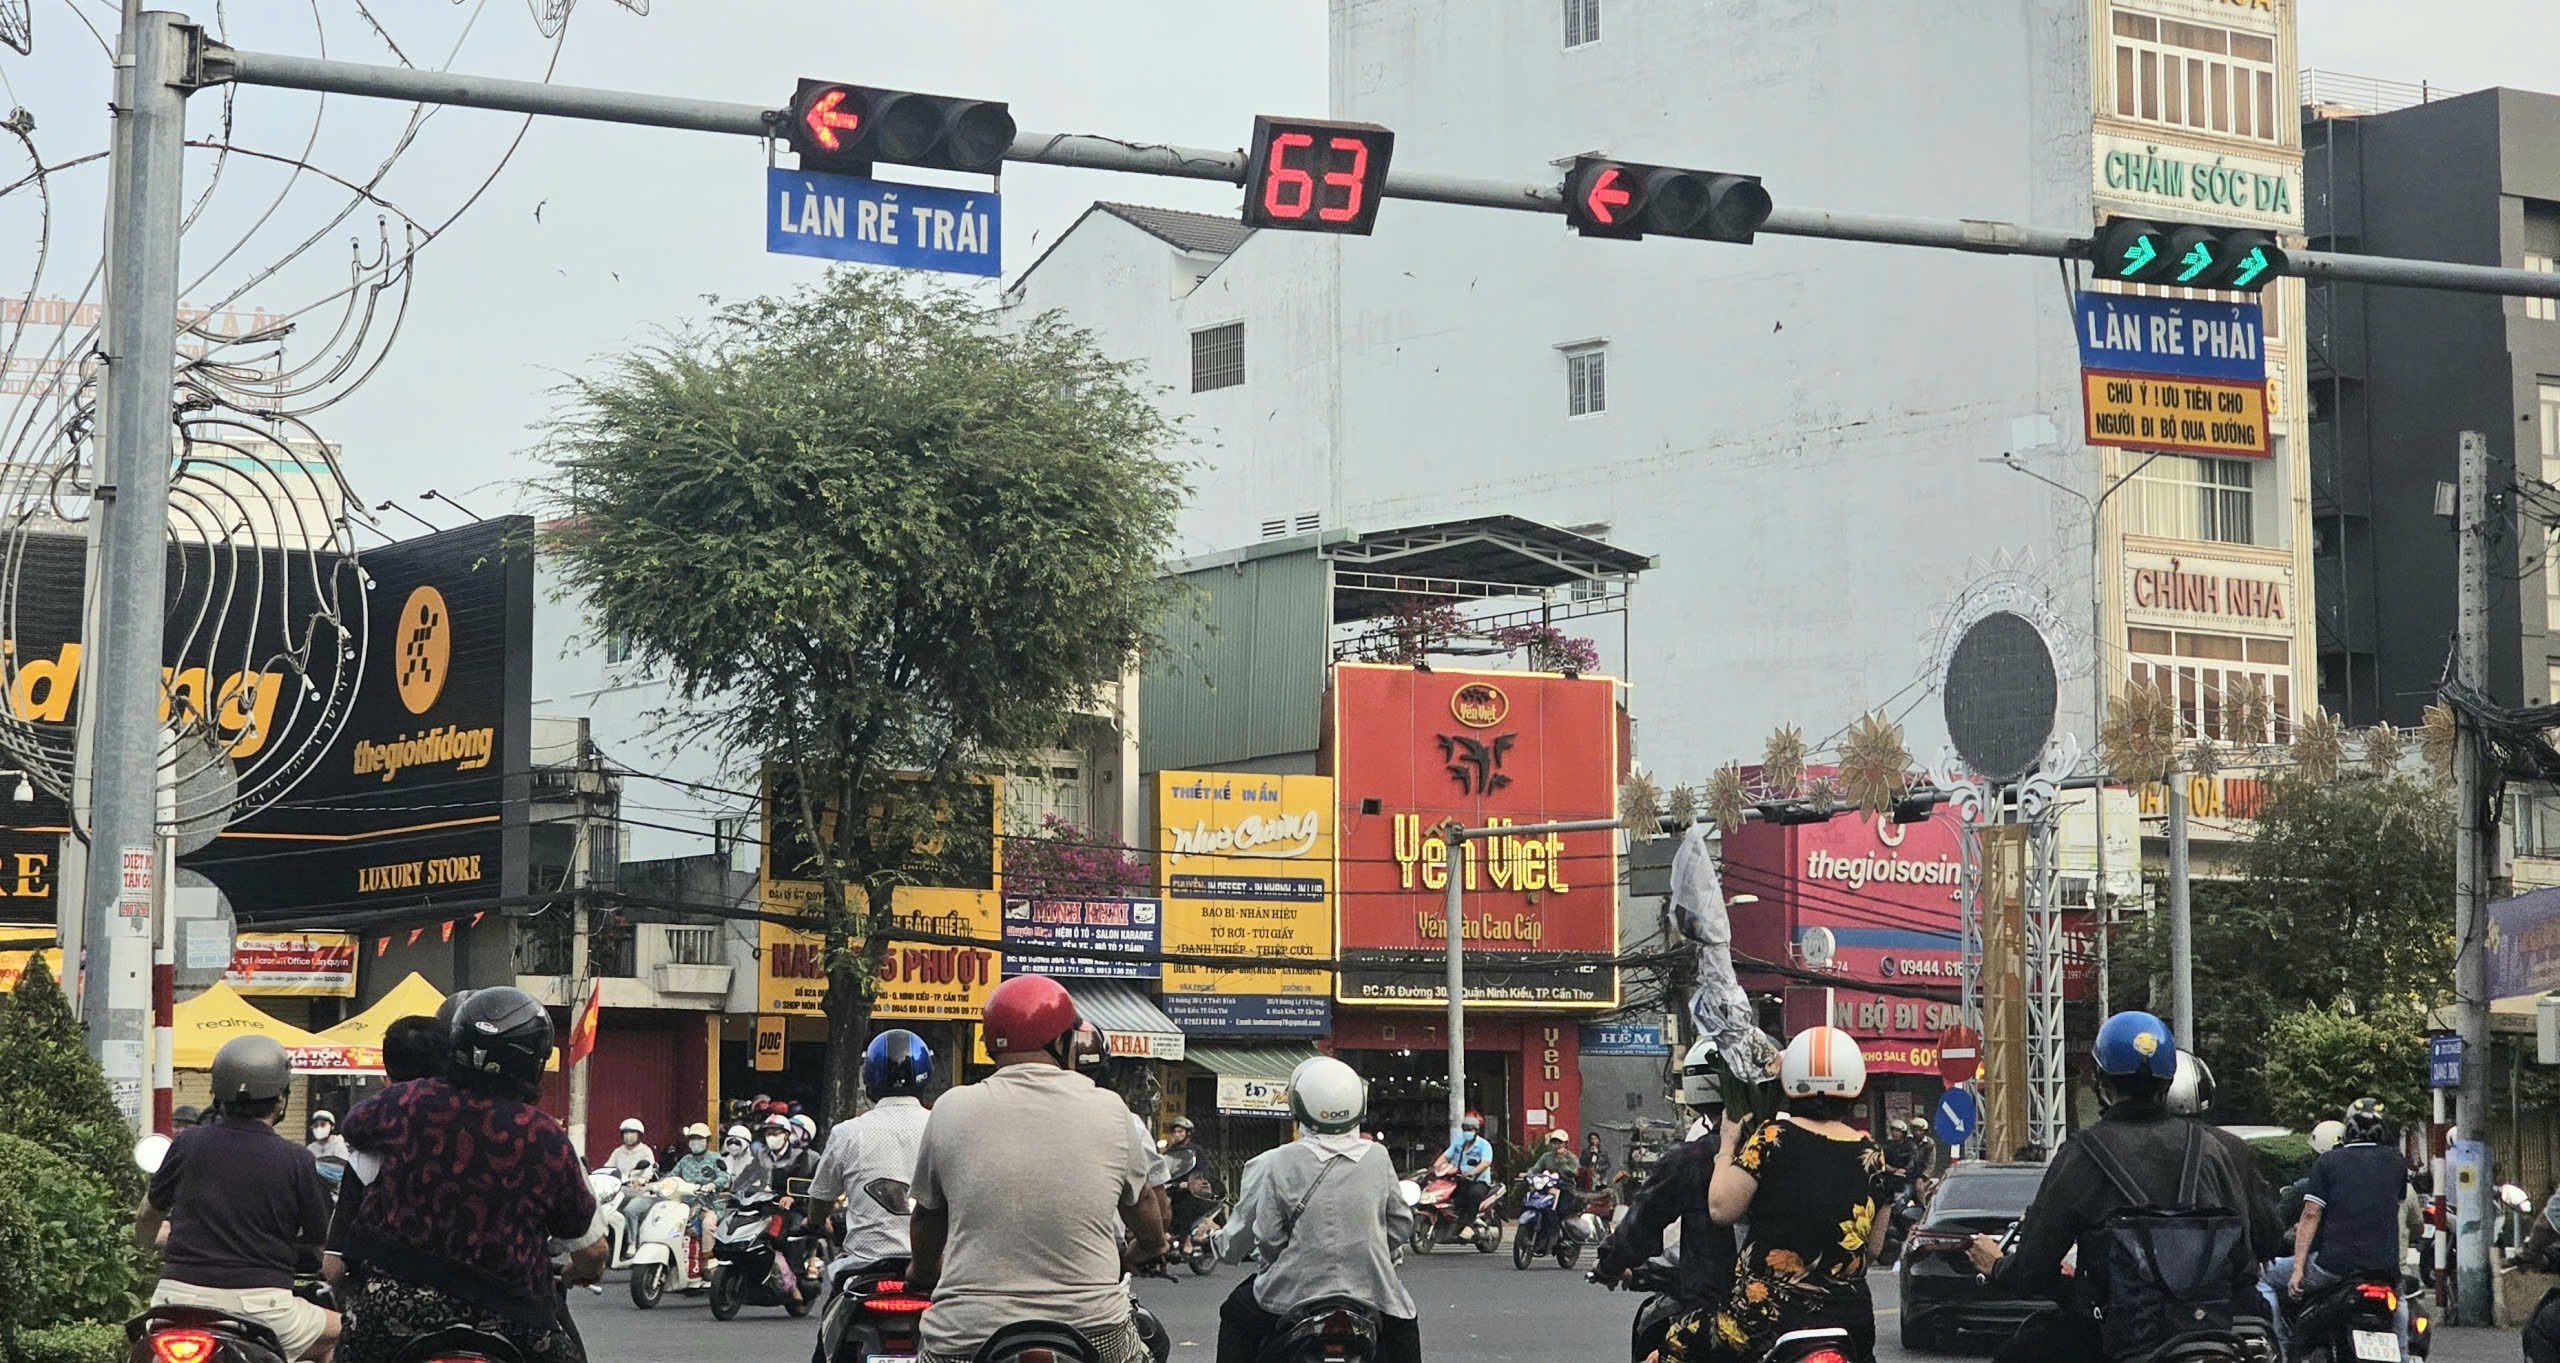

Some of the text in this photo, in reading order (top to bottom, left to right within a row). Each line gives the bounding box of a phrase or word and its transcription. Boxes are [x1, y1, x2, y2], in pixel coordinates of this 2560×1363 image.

[1265, 133, 1368, 221] 63
[2106, 146, 2291, 213] CHĂM SÓC DA
[781, 181, 988, 254] LÀN RẼ TRÁI
[2088, 302, 2255, 360] LÀN RẼ PHẢI
[2107, 380, 2132, 403] CHÚ
[2140, 381, 2147, 405] Ý
[2184, 387, 2212, 411] TIÊN
[2218, 392, 2243, 414] CHO
[2096, 409, 2255, 445] NGƯỜI ĐI BỘ QUA ĐƯỜNG
[2134, 557, 2285, 620] CHỈNH NHA
[1460, 704, 1497, 722] Yến Việt
[353, 725, 493, 782] thegioididong
[1171, 779, 1278, 802] THIẾT KẾ IN ẤN
[358, 855, 481, 892] LUXURY STORE
[1033, 901, 1129, 925] MINH KHAI
[1202, 908, 1223, 917] BAO
[1272, 908, 1297, 920] HIỆU
[1483, 913, 1512, 939] Cao
[1514, 913, 1542, 947] Cấp
[1055, 926, 1072, 938] NỆM
[1095, 930, 1119, 940] SALON
[1120, 930, 1153, 940] KARAOKE
[1252, 928, 1269, 938] TÚI
[1271, 927, 1294, 939] GIẤY
[902, 947, 992, 991] PHƯỢT
[1384, 986, 1396, 997] 76
[1397, 986, 1433, 998] Đường
[1486, 988, 1508, 998] Ninh
[1536, 989, 1550, 999] TP.
[196, 1017, 264, 1031] realme
[1859, 996, 1889, 1035] BỘ
[1895, 1003, 1918, 1030] ĐI
[1109, 1034, 1150, 1056] KHAI
[1884, 1051, 1906, 1062] SALE
